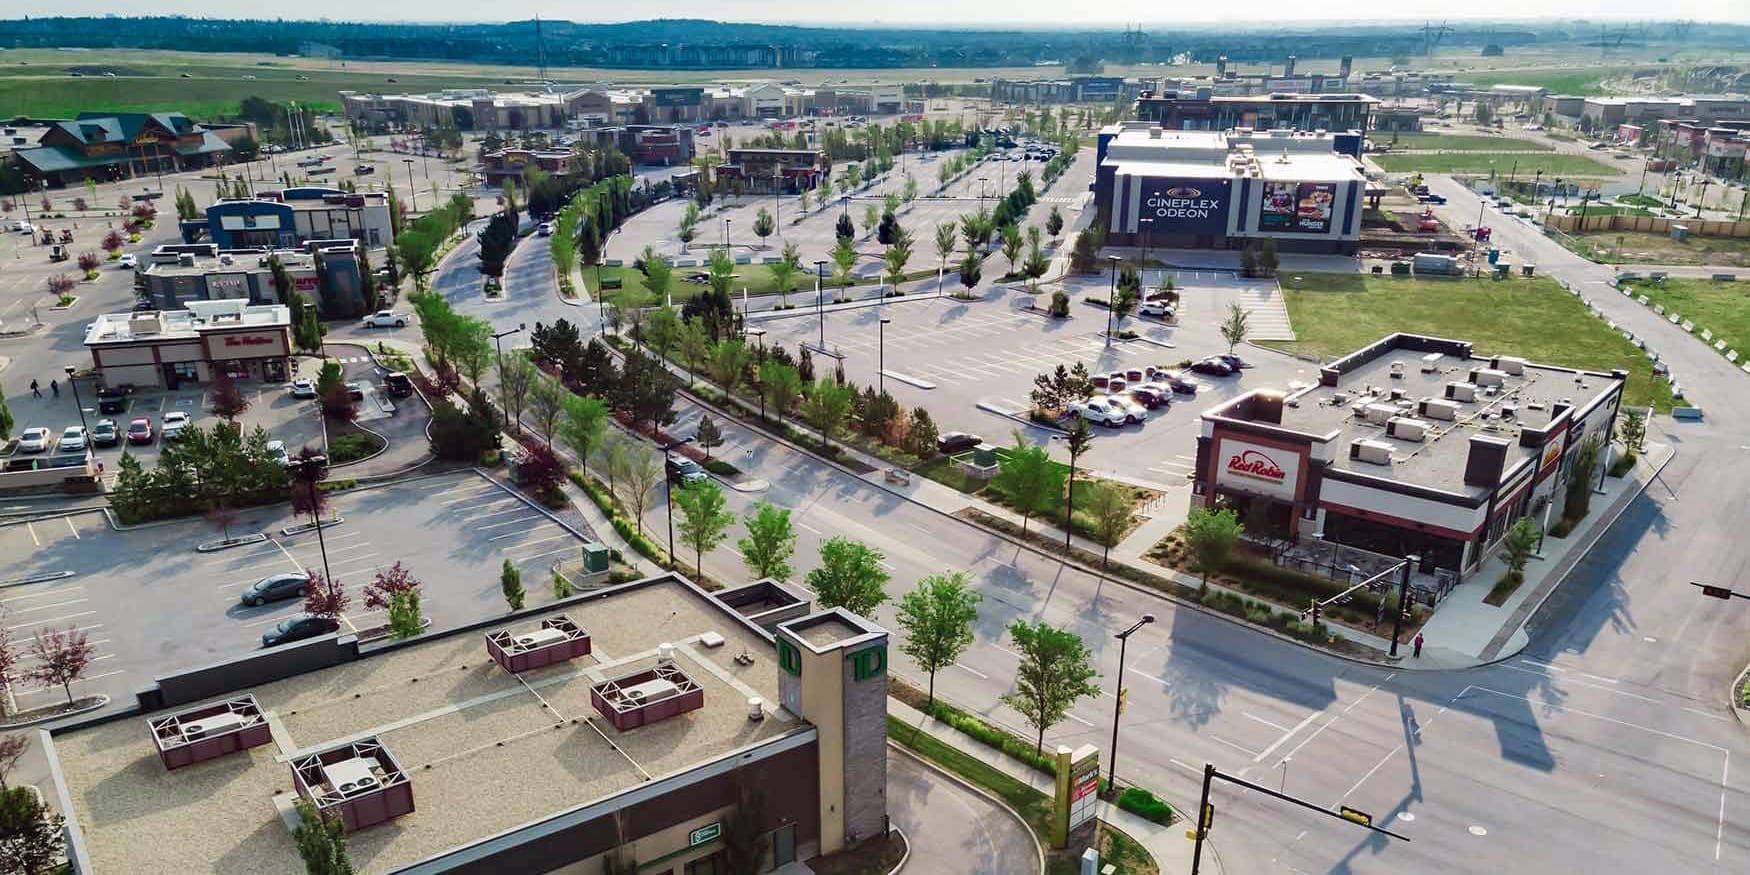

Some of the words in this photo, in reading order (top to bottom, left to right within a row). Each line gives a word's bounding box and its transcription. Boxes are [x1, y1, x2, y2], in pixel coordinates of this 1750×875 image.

[1147, 198, 1219, 209] CINEPLEX
[1156, 208, 1209, 219] ODEON
[1228, 455, 1253, 472] Red
[1250, 460, 1286, 479] Robin
[777, 637, 801, 676] TD
[846, 646, 888, 681] TD
